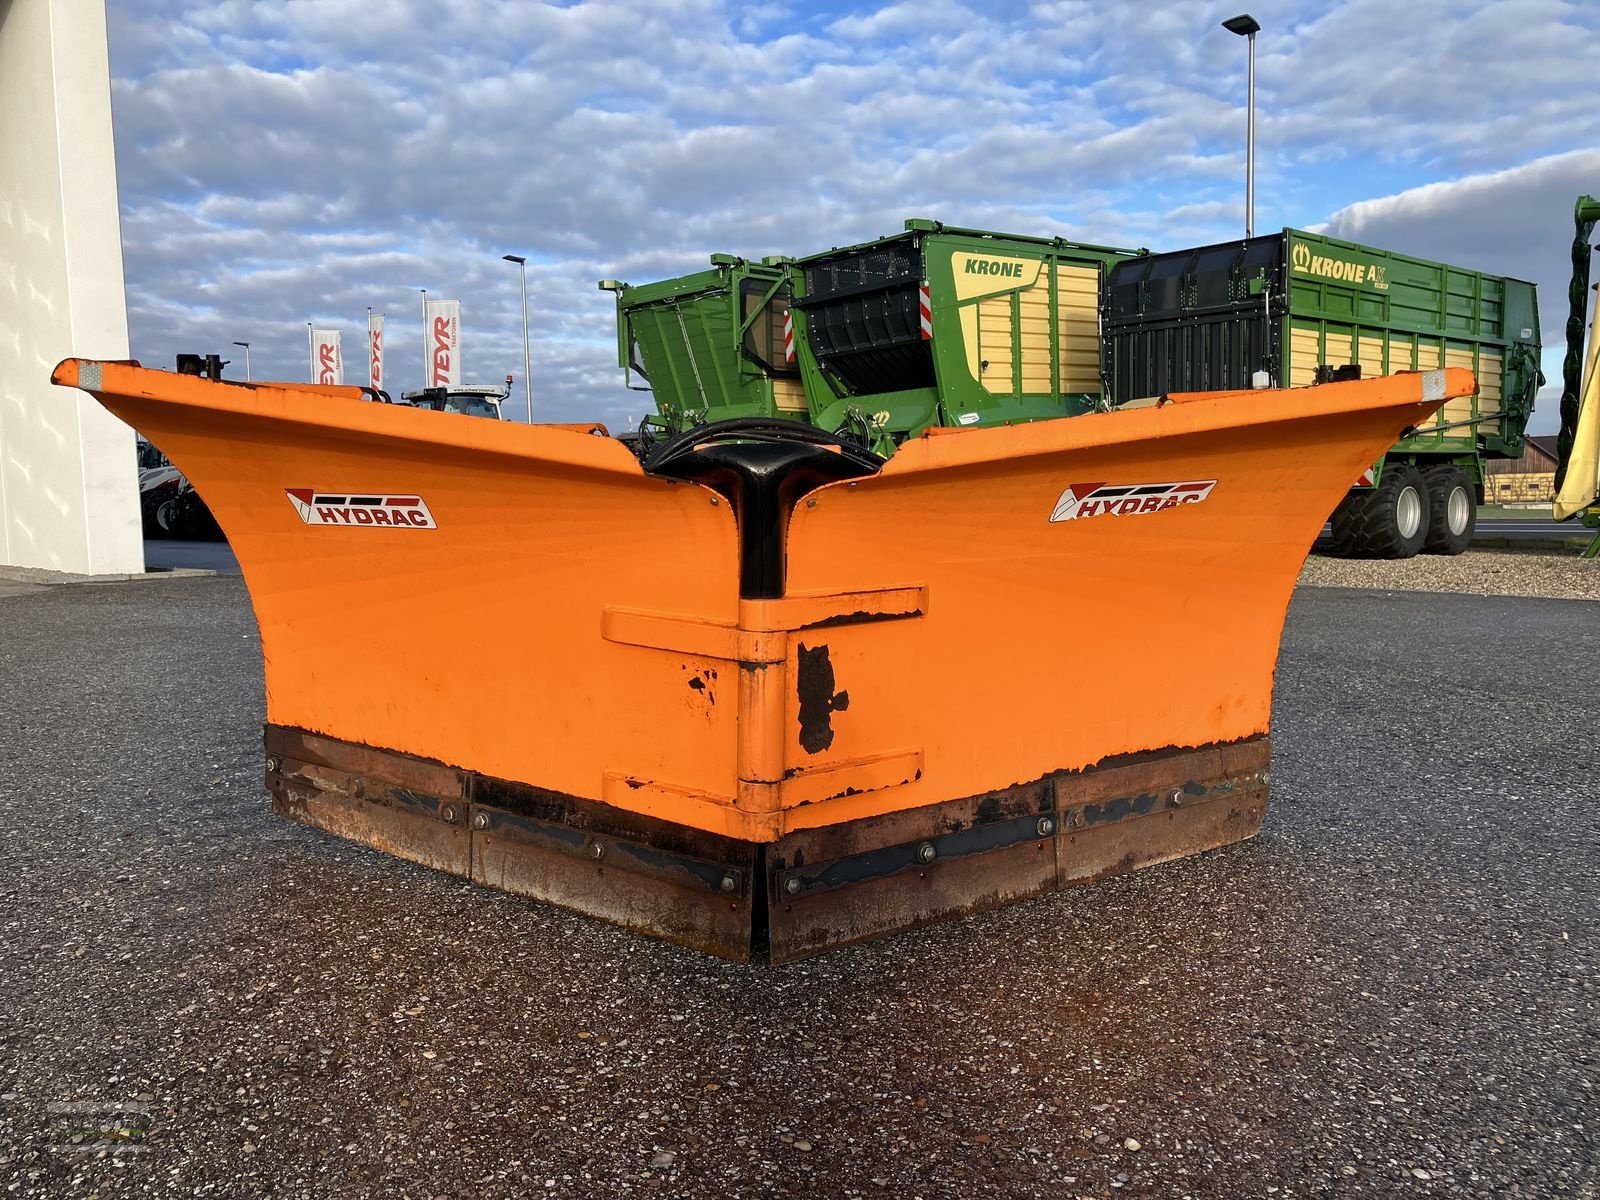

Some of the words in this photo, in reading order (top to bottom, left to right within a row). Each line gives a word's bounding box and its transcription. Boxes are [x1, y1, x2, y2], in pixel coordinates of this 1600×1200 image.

[964, 258, 1023, 278] KRONE
[1310, 255, 1365, 283] KRONE
[1367, 265, 1386, 282] AX
[319, 343, 334, 385] EYR
[433, 316, 450, 387] TEYR
[316, 507, 428, 526] HYDRAC
